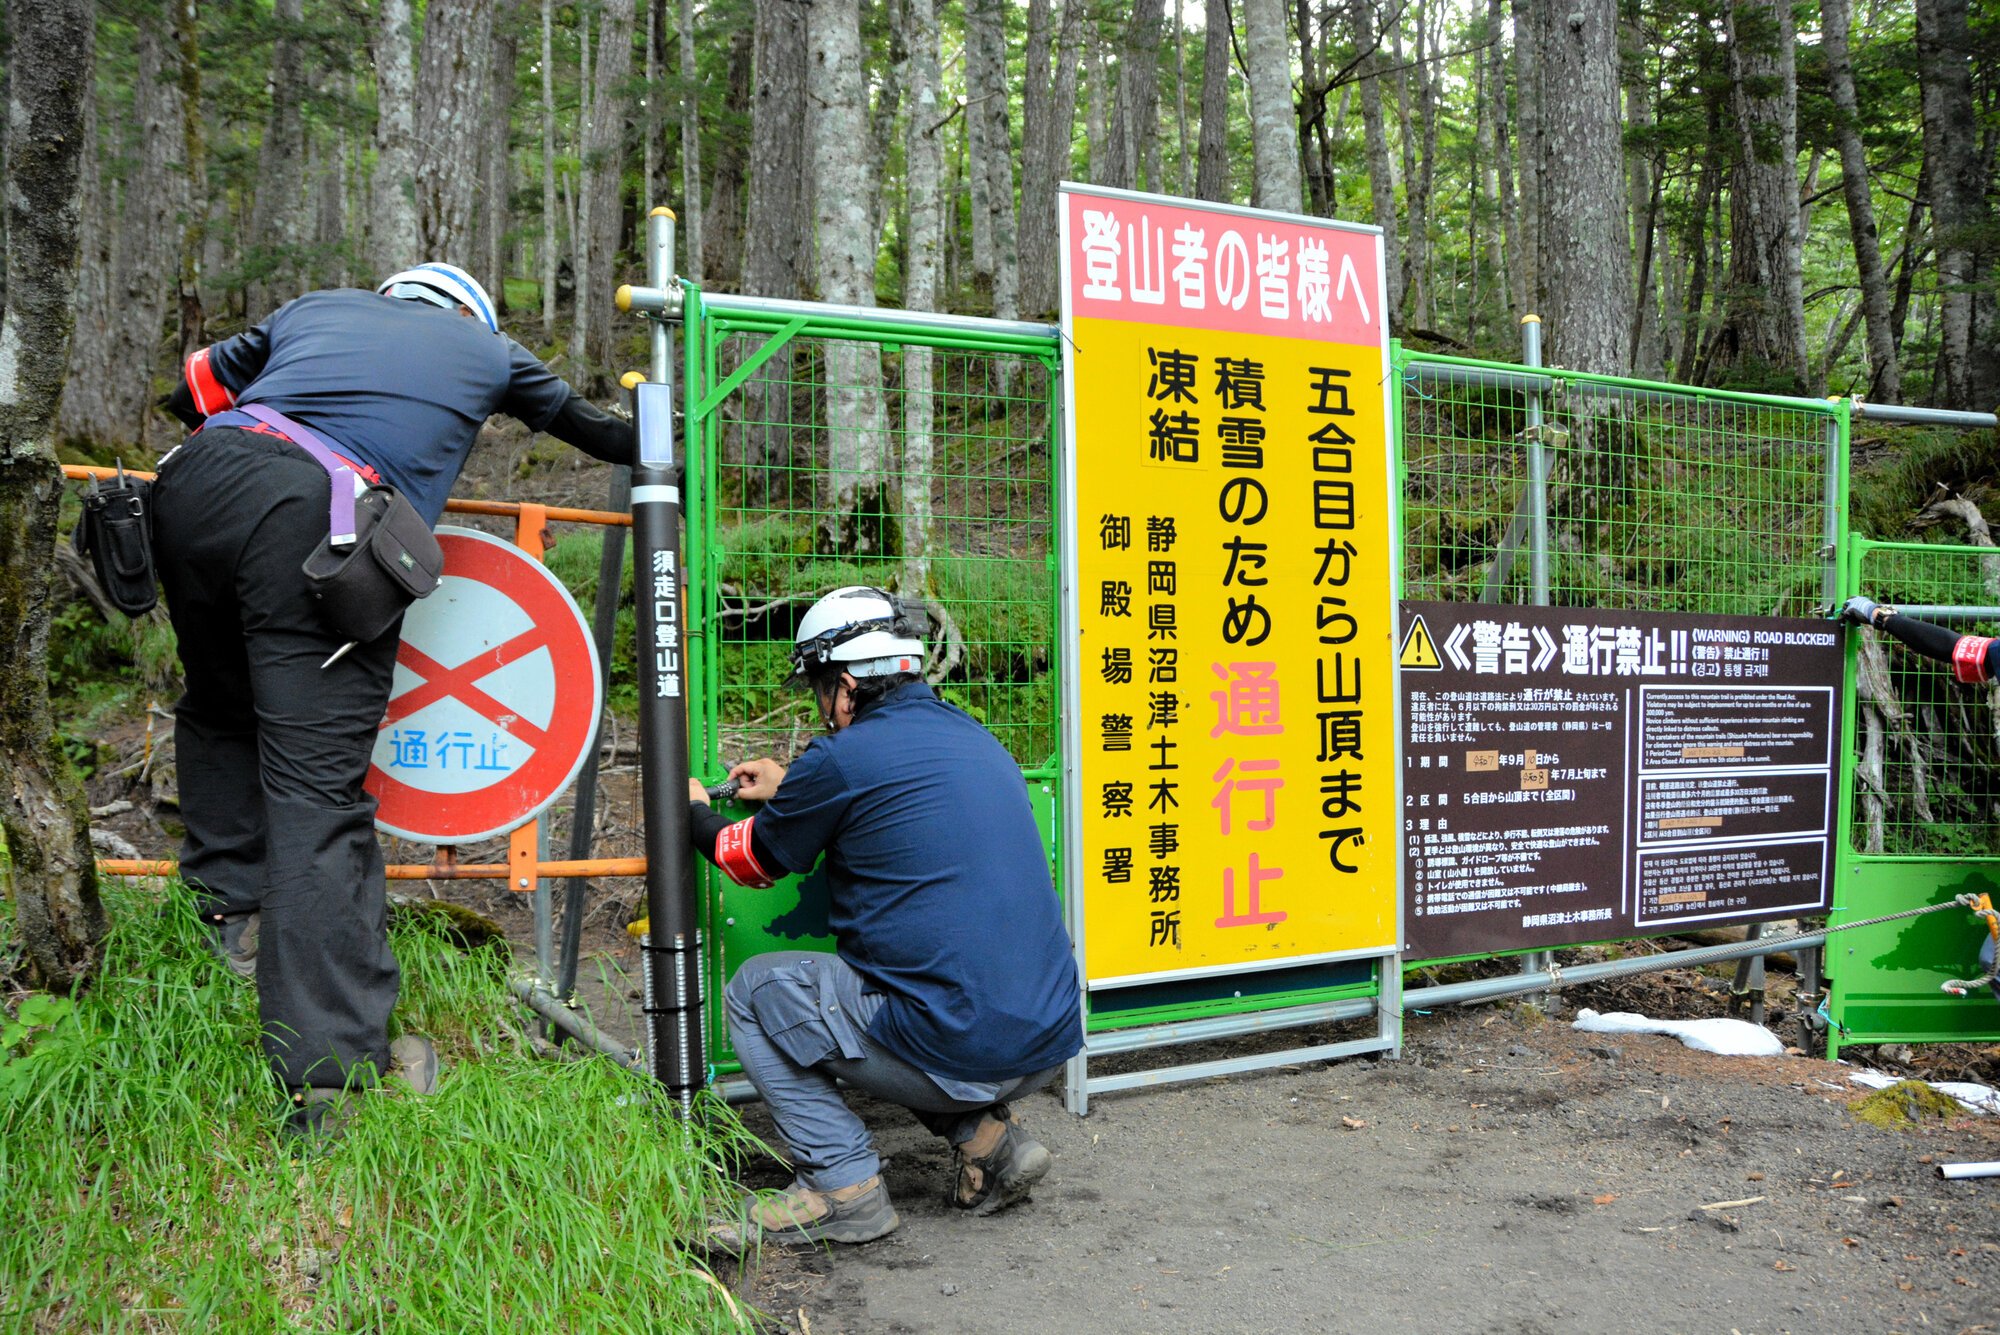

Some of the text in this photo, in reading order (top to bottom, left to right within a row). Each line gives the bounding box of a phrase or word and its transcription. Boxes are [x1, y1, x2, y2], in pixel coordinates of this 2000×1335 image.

[1081, 209, 1370, 324] 登山者の皆様へ
[1147, 347, 1200, 463] 凍結
[653, 550, 680, 697] 須走口登山道
[1307, 366, 1365, 874] 五合目から山頂まで
[1724, 663, 1742, 677] 통행
[1754, 631, 1783, 645] ROAD
[1784, 632, 1836, 646] BLOCKED!!
[389, 729, 511, 771] 通行止
[1099, 513, 1134, 884] 御殿場警察署
[1146, 515, 1181, 947] 静岡県沼津土木事務所
[1406, 795, 1413, 807] 2
[1406, 820, 1413, 831] 3
